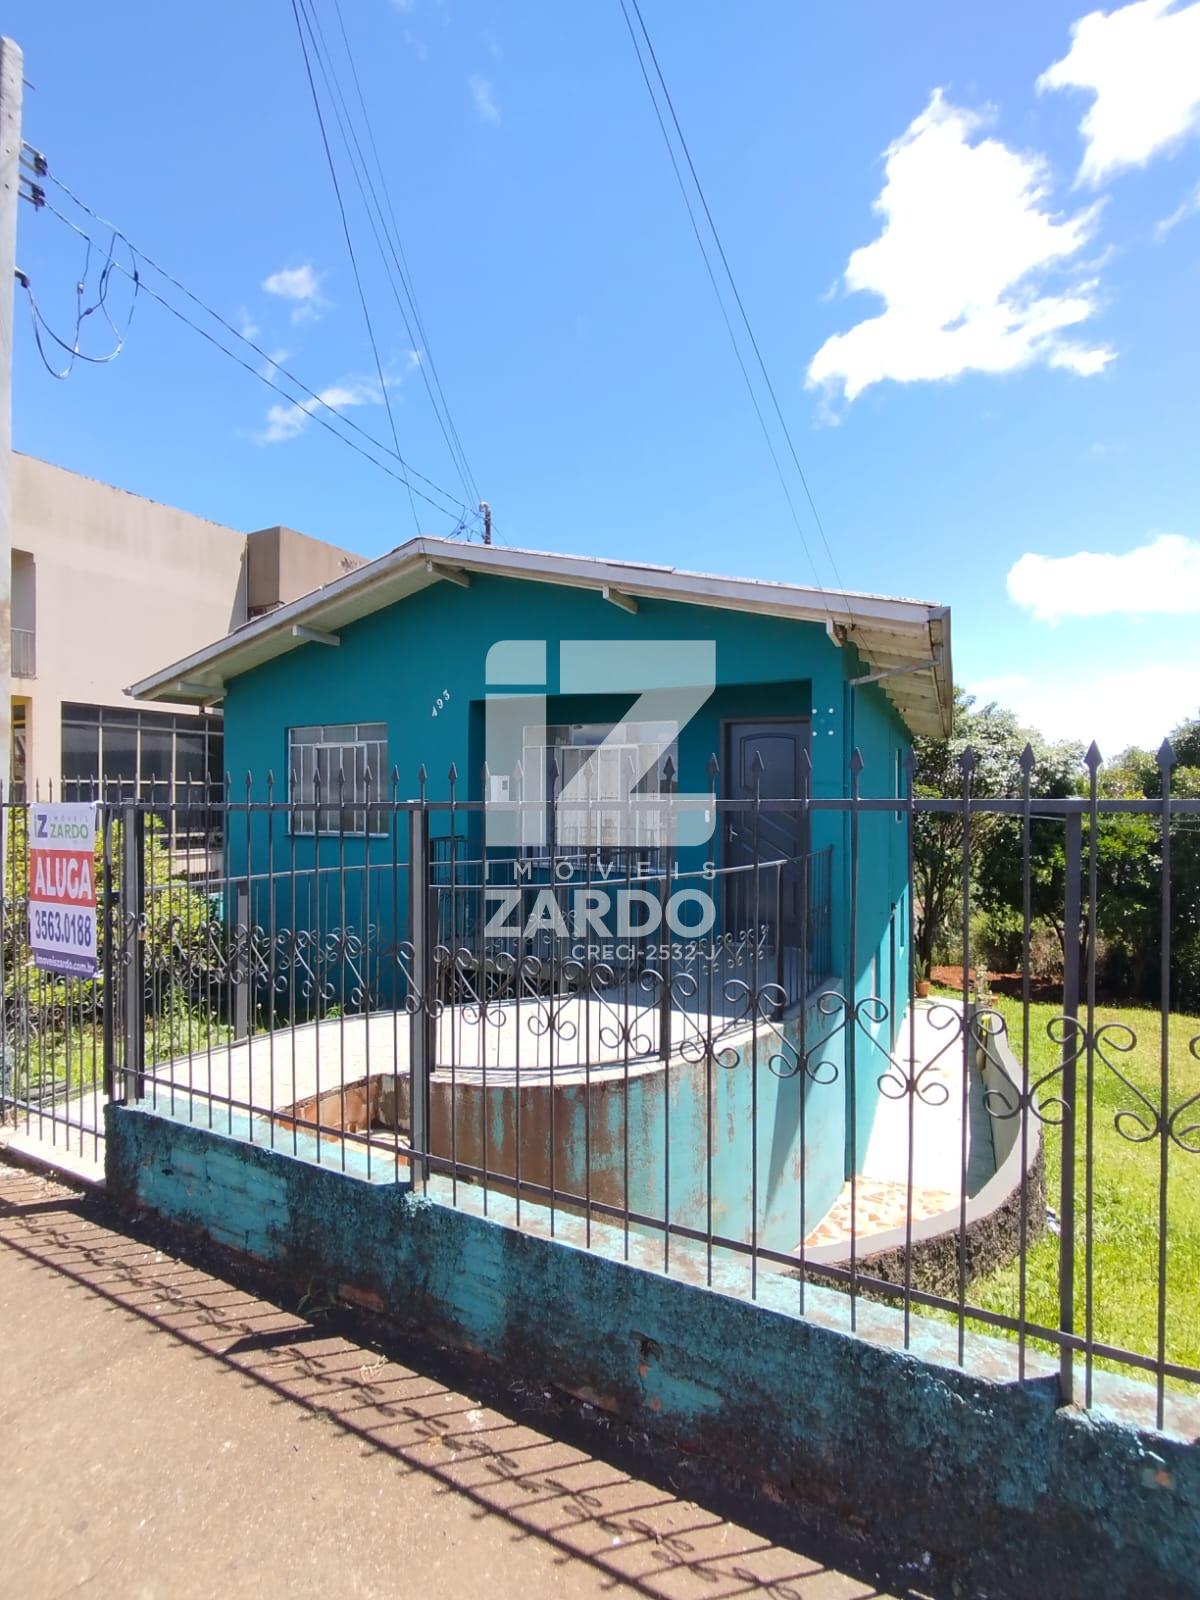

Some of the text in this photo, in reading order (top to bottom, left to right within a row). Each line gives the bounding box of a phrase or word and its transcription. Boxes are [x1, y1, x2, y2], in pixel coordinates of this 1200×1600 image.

[50, 824, 89, 839] ZARDO
[35, 857, 92, 899] ALUGA
[35, 910, 91, 947] 3563.0188
